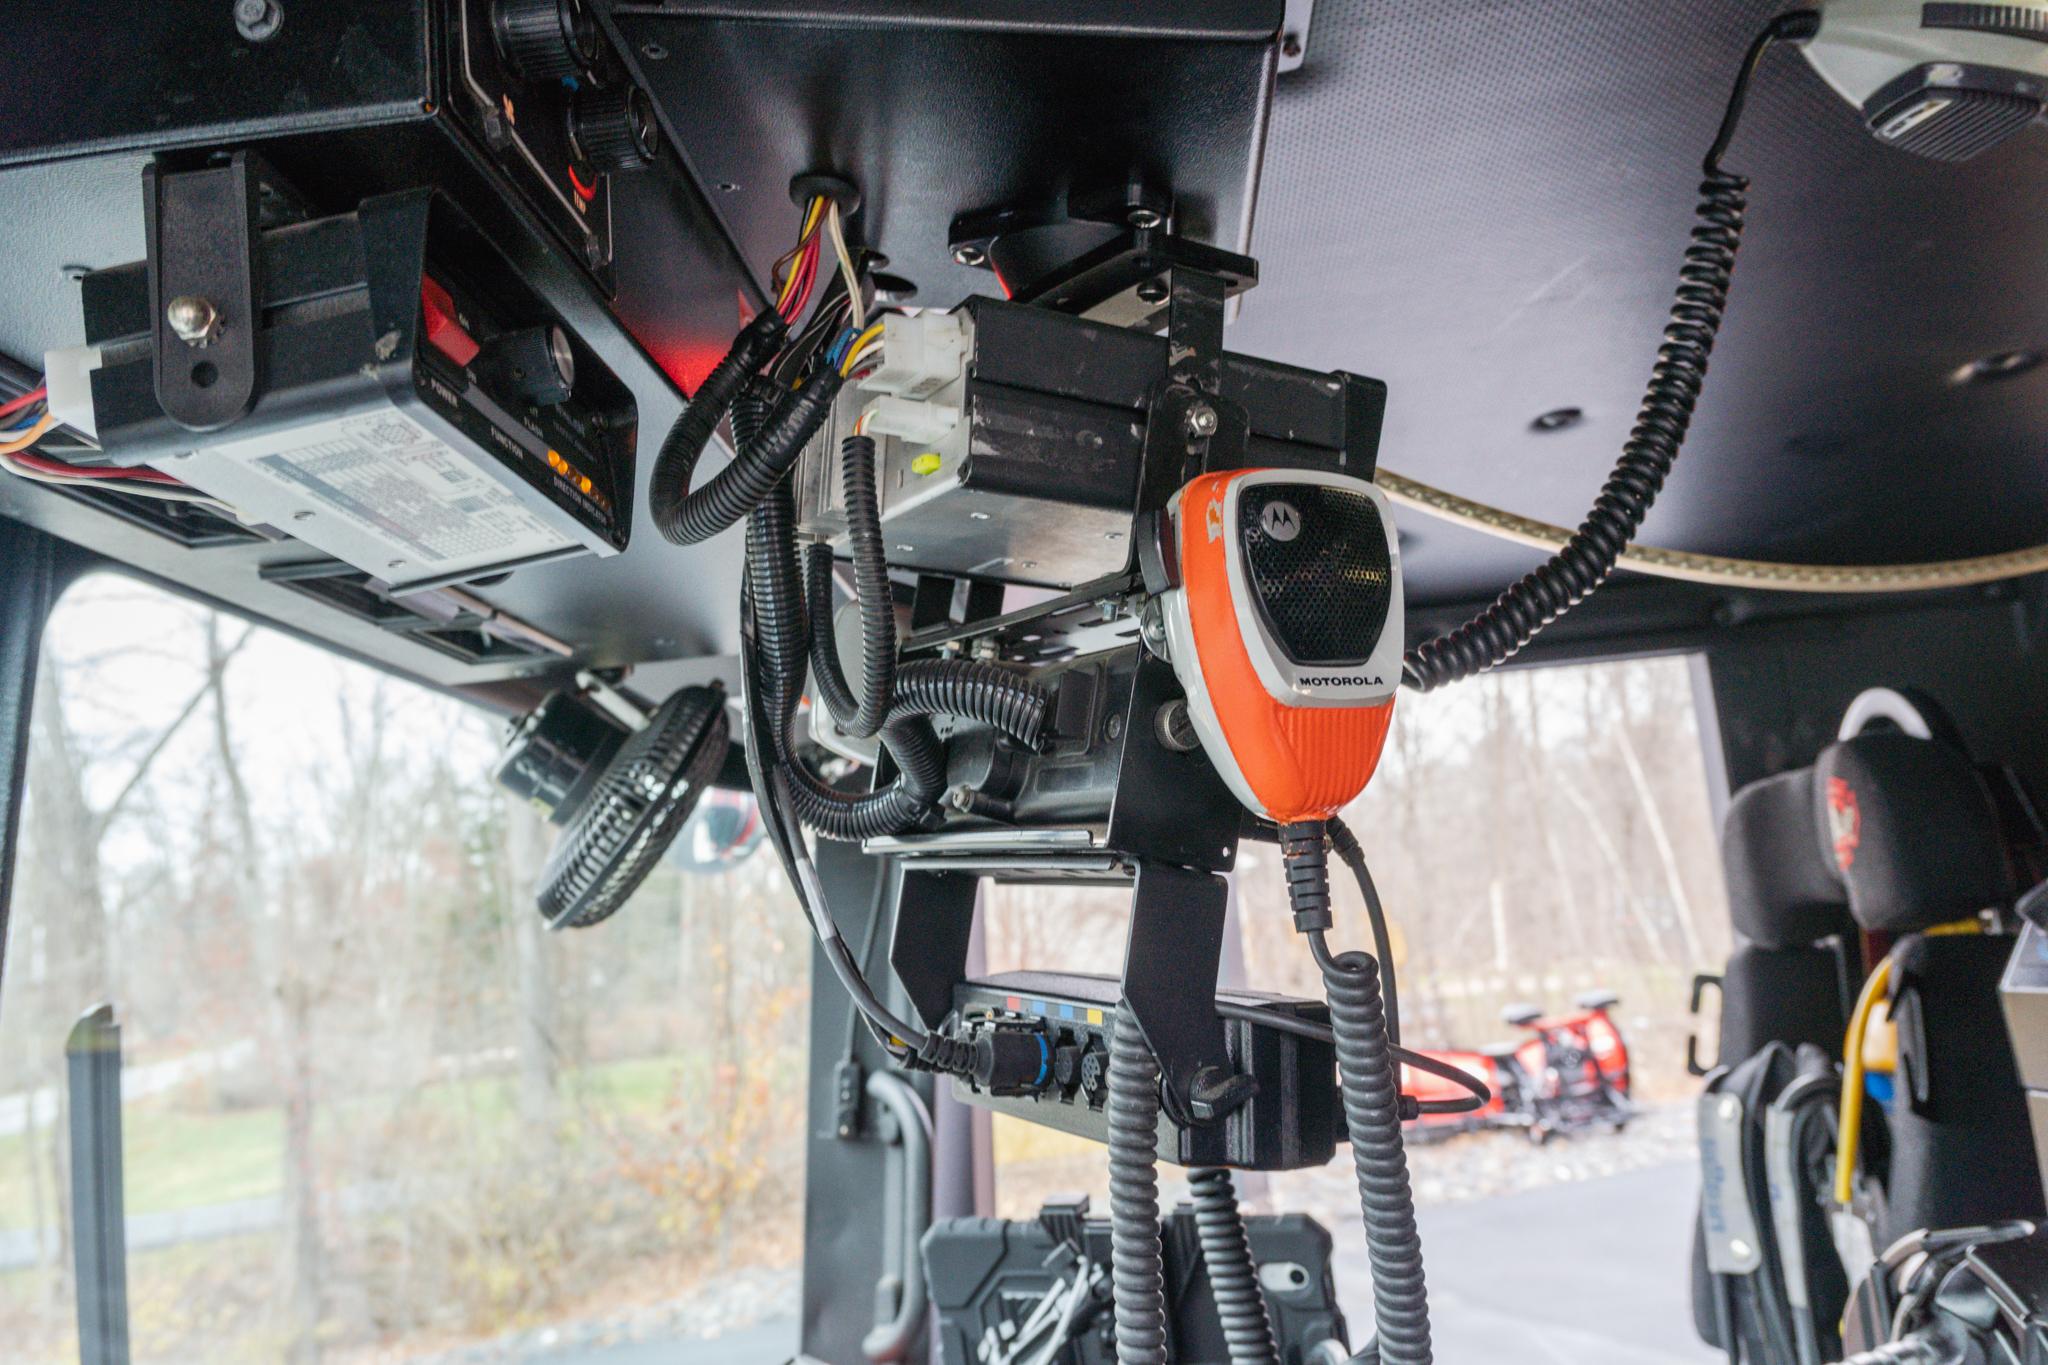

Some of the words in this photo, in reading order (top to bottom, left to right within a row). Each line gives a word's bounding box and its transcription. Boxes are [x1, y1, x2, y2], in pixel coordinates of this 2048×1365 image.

[431, 378, 458, 409] POWER
[490, 426, 524, 460] FUNCTION
[553, 476, 582, 508] DIRECTION
[1299, 676, 1384, 686] MOTOROLA
